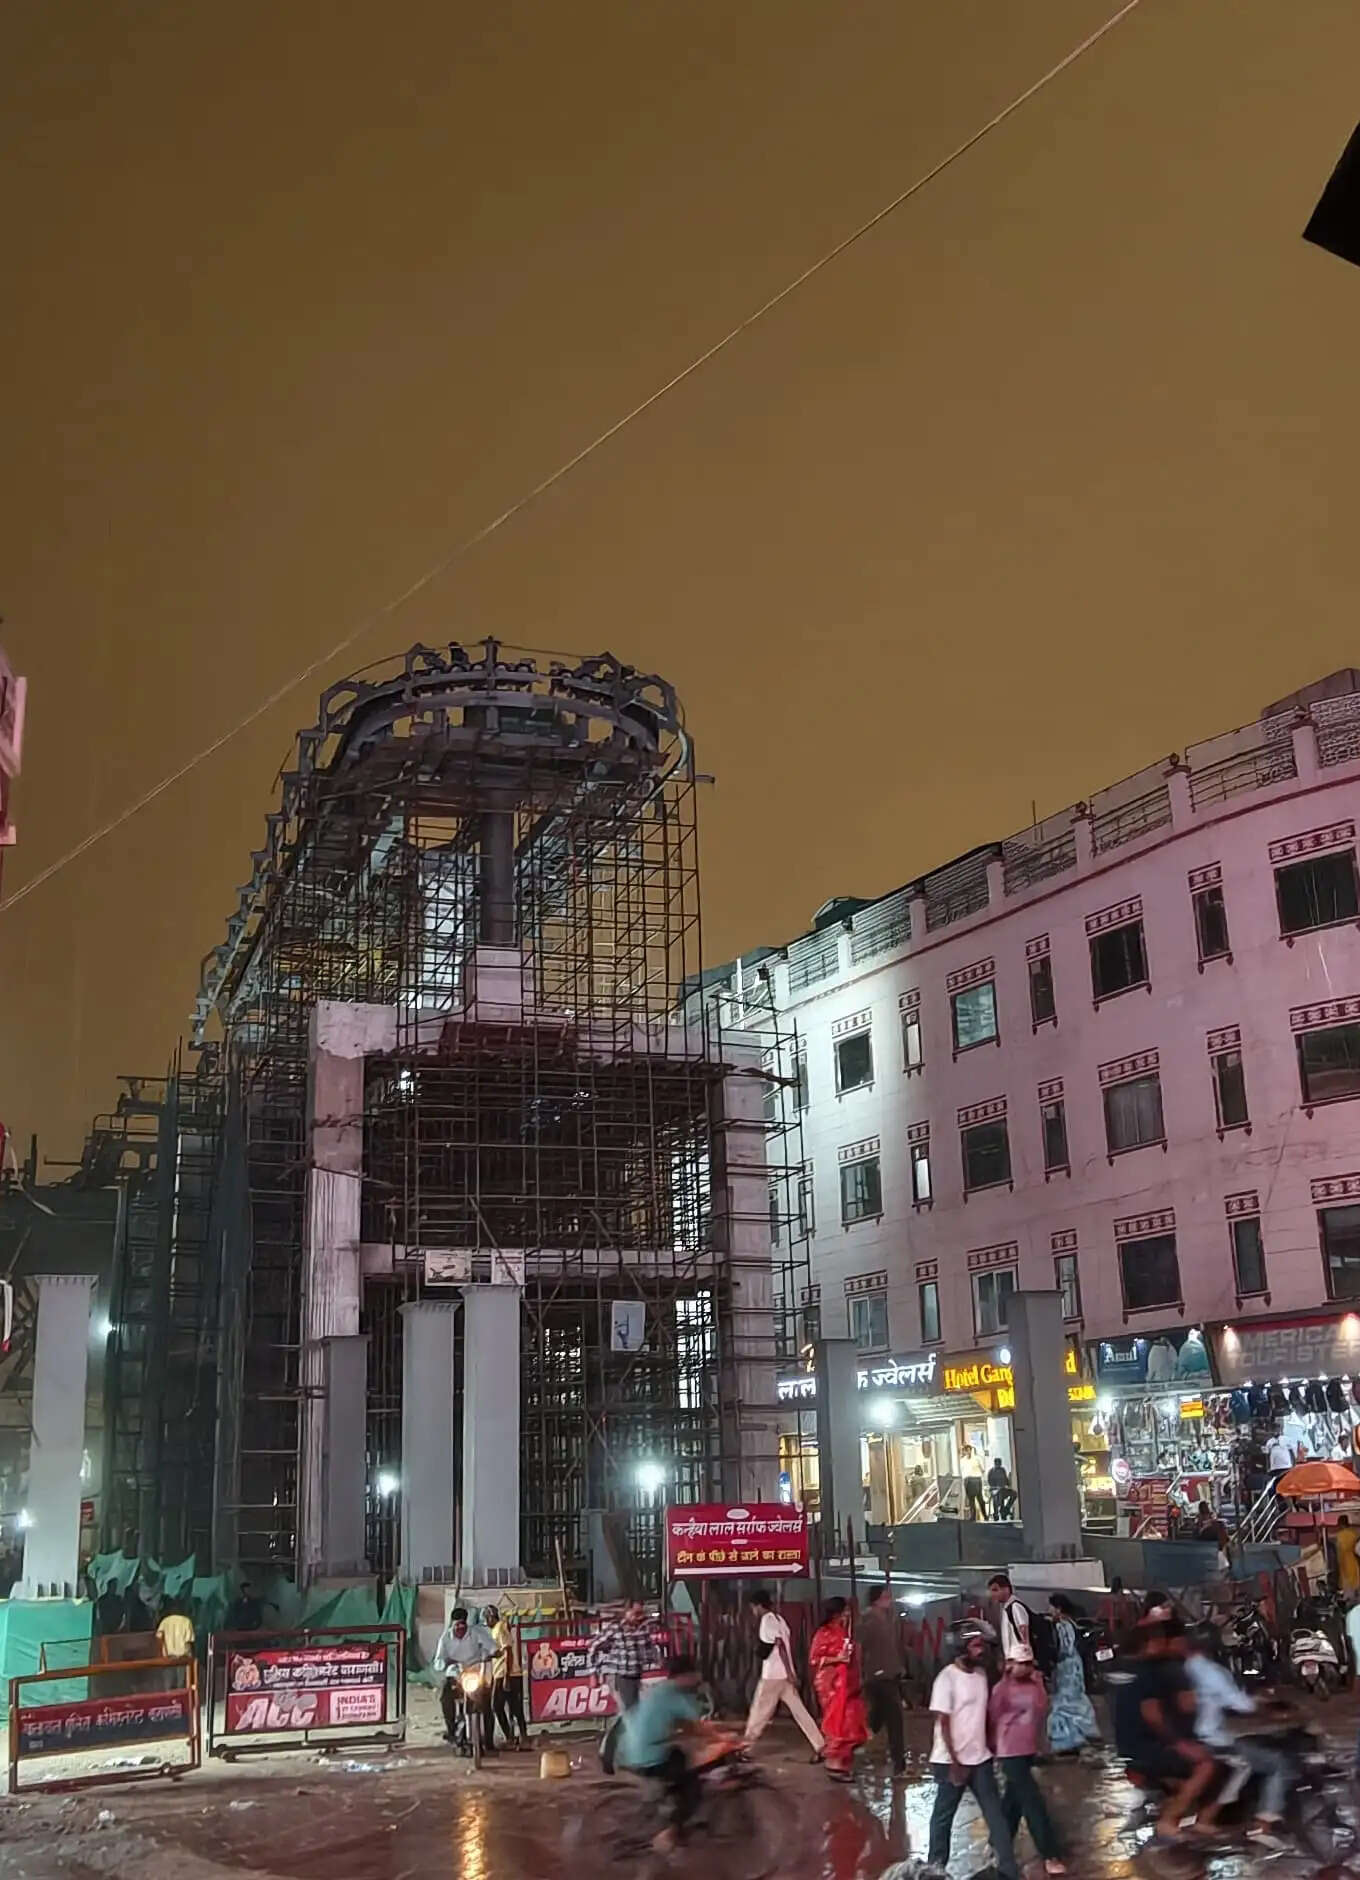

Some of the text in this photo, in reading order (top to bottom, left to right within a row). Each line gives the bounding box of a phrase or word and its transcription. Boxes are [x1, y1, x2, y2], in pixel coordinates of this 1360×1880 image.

[871, 1353, 937, 1387] ज्वेलर्स
[944, 1364, 980, 1390] Hotel
[709, 1522, 734, 1536] लाल
[234, 1692, 318, 1731] ACC
[543, 1684, 610, 1718] ACC
